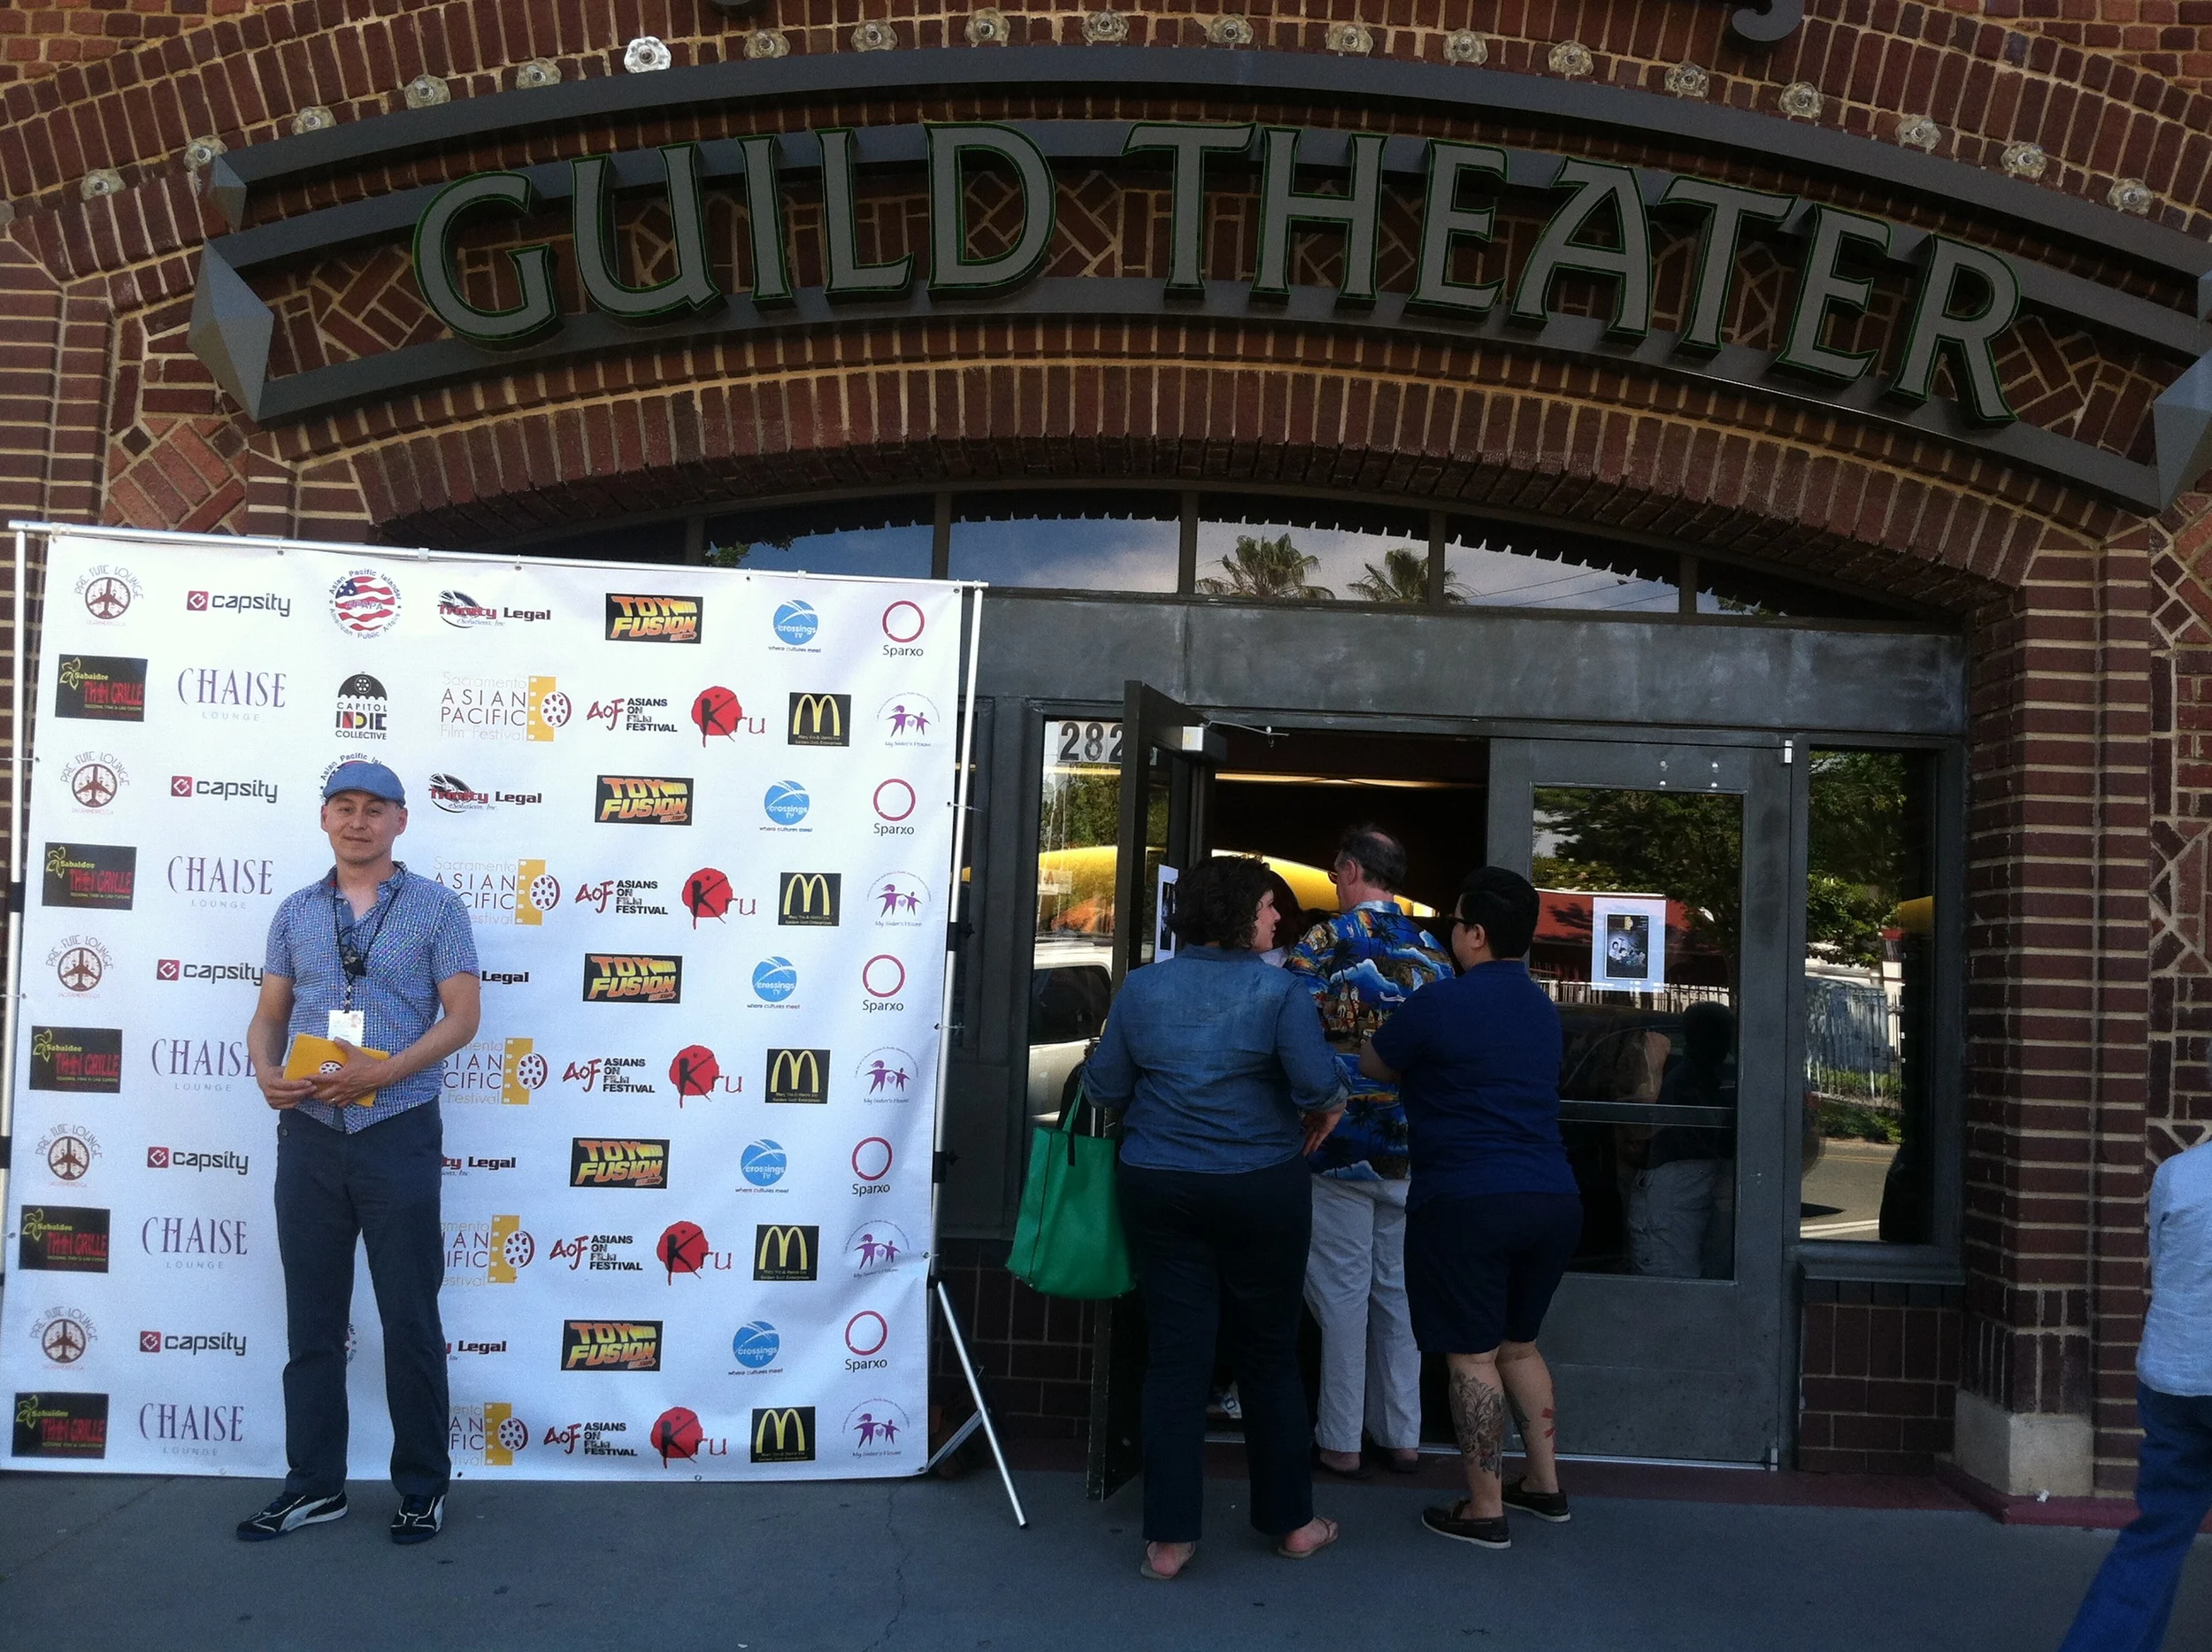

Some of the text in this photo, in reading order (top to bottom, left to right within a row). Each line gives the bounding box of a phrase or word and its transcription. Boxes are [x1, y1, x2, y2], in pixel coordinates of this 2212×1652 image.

[411, 120, 2022, 422] GUILD THEATER
[329, 569, 401, 601] Asian Pacific Islander
[212, 593, 290, 617] capsity
[611, 595, 674, 618] TOY
[503, 607, 550, 621] Legal
[357, 630, 380, 639] Public
[611, 617, 697, 639] FUSION
[778, 623, 817, 634] crossings
[883, 645, 924, 657] Sparxo
[178, 667, 287, 708] CHAISE
[442, 688, 526, 707] ASIAN
[627, 697, 667, 707] ASIANS
[337, 702, 388, 711] CAPITOL
[627, 706, 642, 715] ON
[202, 711, 259, 721] LOUNGE
[335, 711, 387, 730] INDIE
[442, 708, 526, 726] PACIFIC
[587, 697, 624, 731] AoF
[626, 722, 678, 733] FESTIVAL
[335, 730, 387, 740] COLLECTIVE
[320, 761, 337, 781] Asian
[196, 780, 278, 803] capsity
[602, 778, 666, 798] TOY
[495, 791, 541, 805] Legal
[601, 798, 687, 819] FUSION
[769, 806, 808, 816] crossings
[874, 823, 914, 835] Sparxo
[168, 856, 273, 895] CHAISE
[617, 880, 657, 888] ASIANS
[575, 880, 614, 913] AoF
[617, 888, 633, 897] ON
[192, 899, 246, 910] LOUNGE
[459, 892, 515, 910] CIFIC
[616, 905, 668, 915] FESTIVAL
[472, 911, 513, 925] estival
[590, 956, 655, 977] TOY
[183, 963, 263, 986] capsity
[482, 971, 529, 984] Legal
[588, 976, 675, 999] FUSION
[757, 982, 795, 991] crossings
[862, 1000, 904, 1012] Sparxo
[444, 1072, 501, 1089] CIFIC
[563, 1059, 602, 1093] AoF
[175, 1083, 231, 1092] LOUNGE
[603, 1084, 655, 1094] FESTIVAL
[578, 1141, 642, 1161] TOY
[173, 1151, 249, 1175] capsity
[468, 1156, 516, 1171] Legal
[746, 1164, 784, 1174] crossings
[576, 1161, 662, 1184] FUSION
[852, 1183, 890, 1196] Sparxo
[142, 1217, 247, 1255] CHAISE
[591, 1235, 633, 1244] ASIANS
[447, 1251, 488, 1268] IFIC
[549, 1236, 589, 1271] AoF
[166, 1260, 223, 1269] LOUNGE
[590, 1261, 642, 1271] FESTIVAL
[570, 1322, 636, 1344] TOY
[165, 1332, 246, 1356] capsity
[458, 1341, 506, 1355] Legal
[566, 1342, 656, 1368] FUSION
[738, 1346, 777, 1357] crossings
[845, 1358, 887, 1372] Sparxo
[140, 1402, 243, 1441] CHAISE
[584, 1423, 626, 1432] ASIANS
[543, 1423, 581, 1455] AoF
[584, 1431, 601, 1440] ON
[584, 1448, 637, 1456] FESTIVAL
